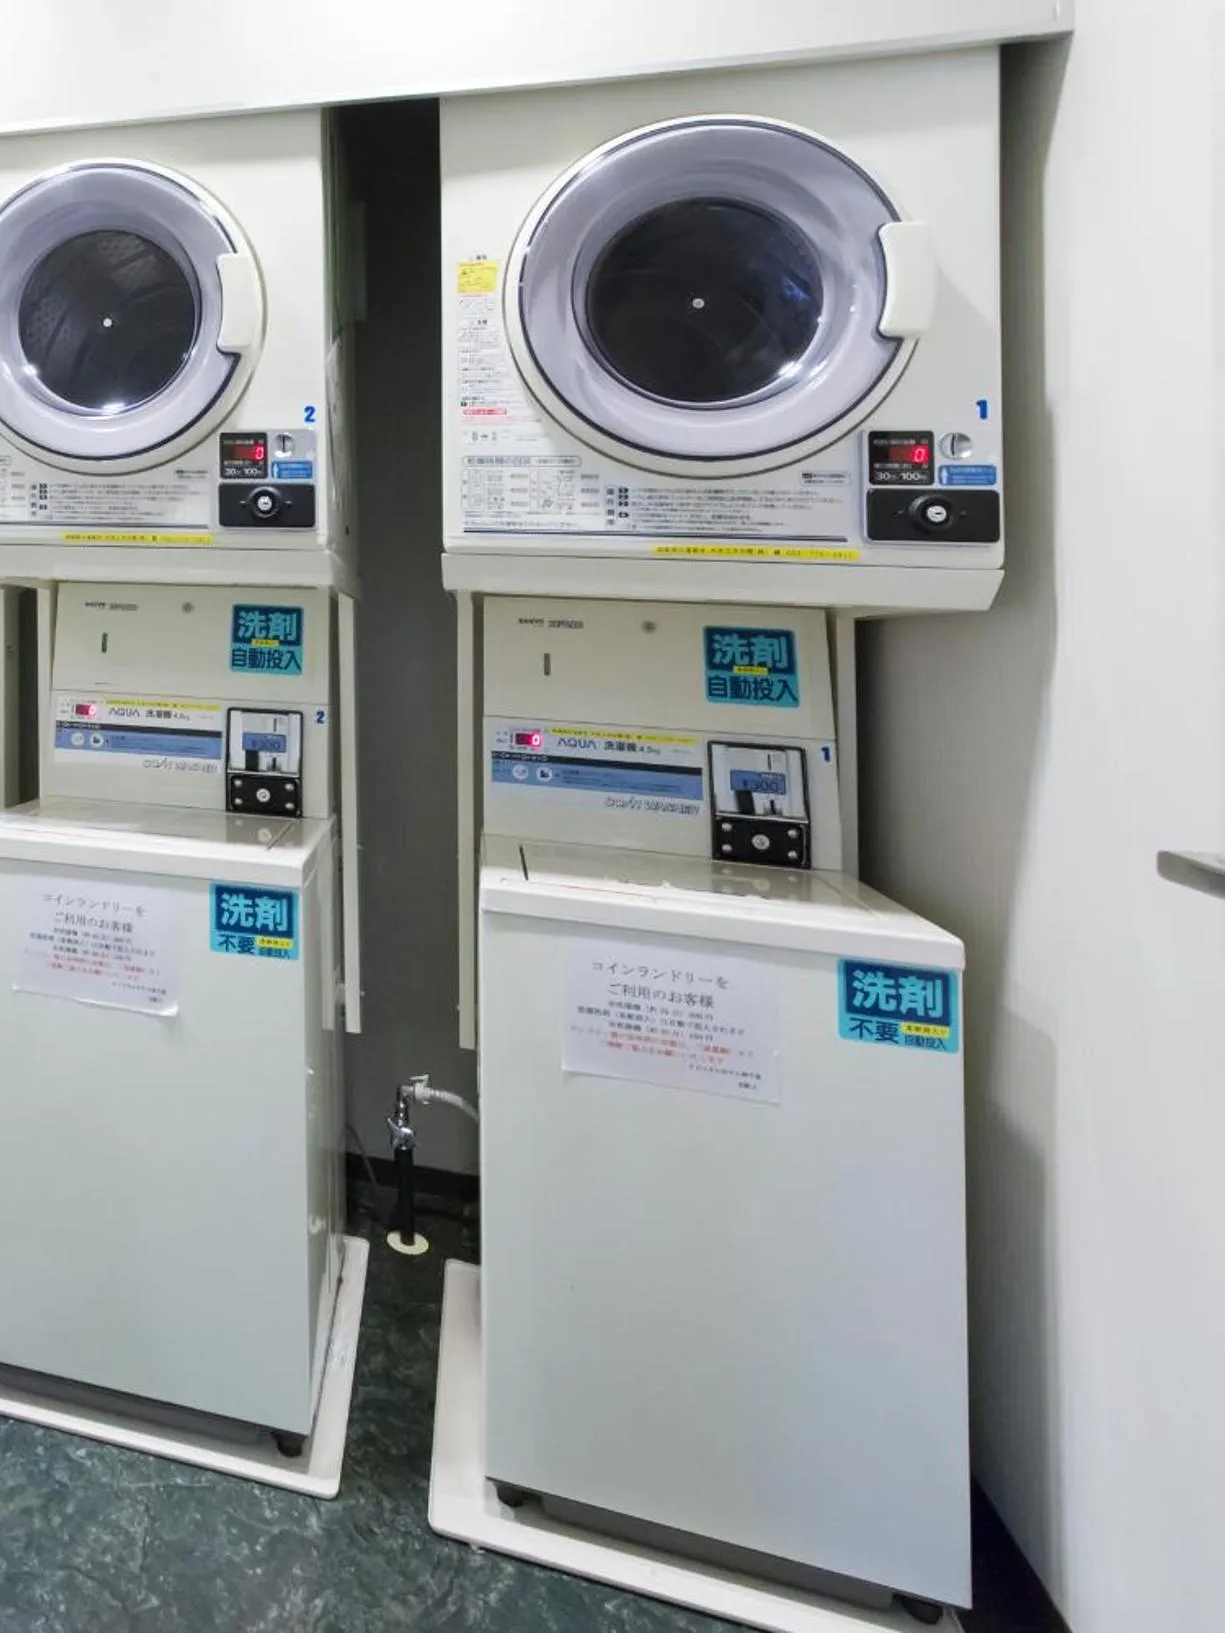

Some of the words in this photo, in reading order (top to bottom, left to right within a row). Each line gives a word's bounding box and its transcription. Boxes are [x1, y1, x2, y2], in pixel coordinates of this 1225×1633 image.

[304, 405, 316, 422] 2
[976, 399, 987, 419] 1
[256, 446, 264, 460] 0
[913, 447, 926, 462] 0
[238, 610, 297, 641] 洗剤
[232, 648, 302, 671] 自動投入
[713, 633, 789, 669] 洗剤
[708, 675, 798, 702] 自動投入
[109, 707, 140, 718] AQUA
[316, 711, 325, 724] 2
[558, 737, 597, 750] AQUA
[821, 747, 830, 762] 1
[220, 892, 288, 931] 洗剤
[219, 934, 255, 953] 不要
[592, 961, 730, 990] コインランドリーを
[607, 982, 714, 1008] ご利用のお客様
[852, 969, 943, 1018] 洗剤
[849, 1017, 899, 1044] 不要
